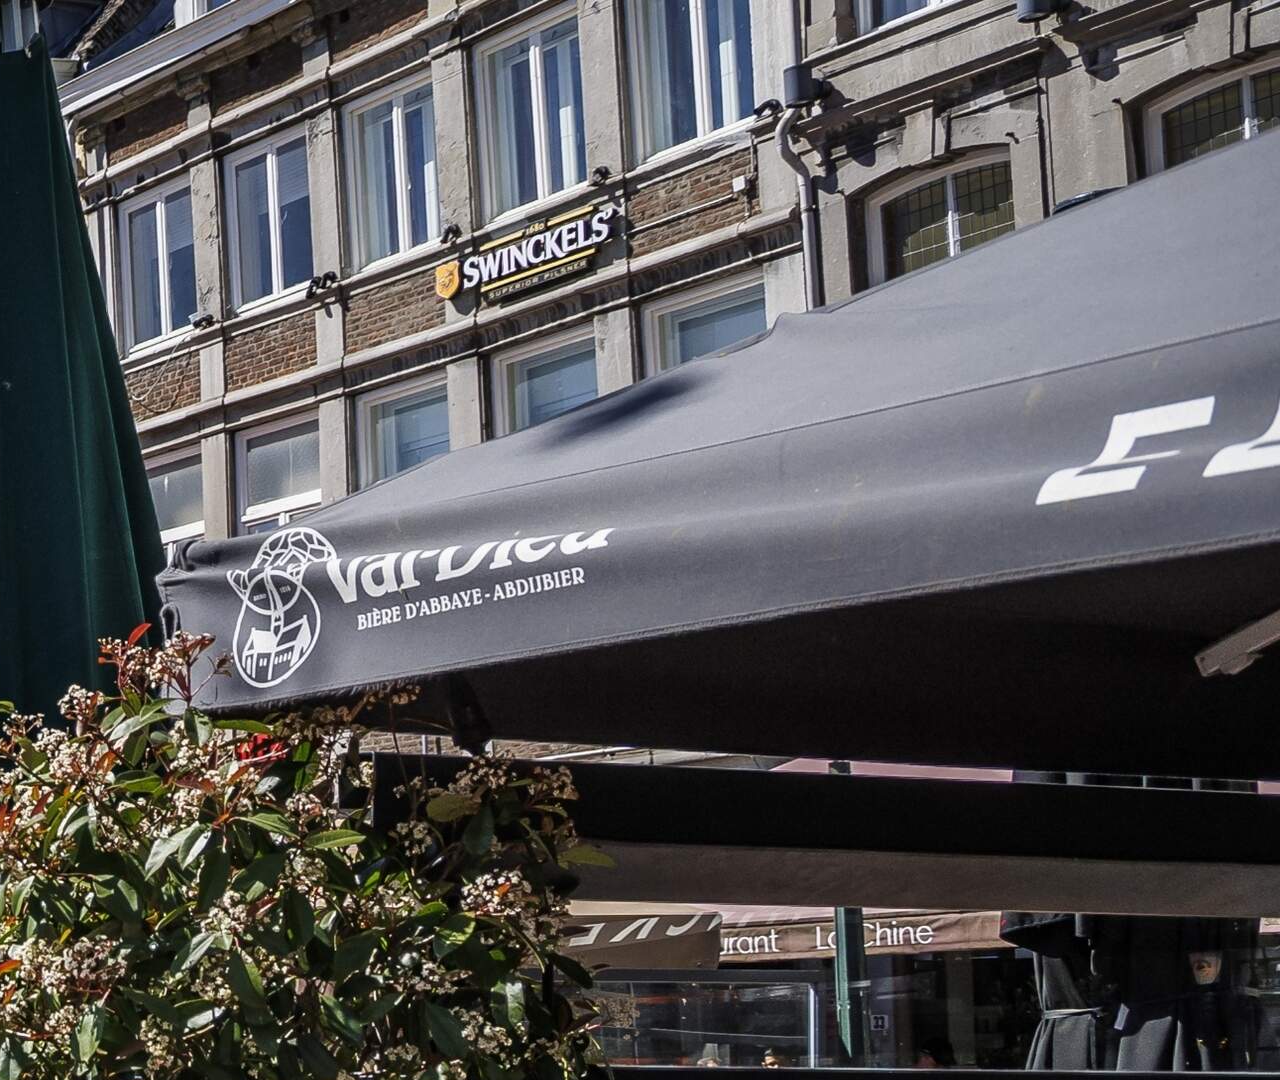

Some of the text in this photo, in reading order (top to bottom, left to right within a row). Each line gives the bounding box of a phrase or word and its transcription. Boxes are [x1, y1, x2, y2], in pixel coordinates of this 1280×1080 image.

[463, 208, 613, 289] SWINCKELS'
[489, 260, 587, 299] SUPERIOR PILSNER
[357, 605, 402, 631] BIÈRE
[405, 588, 483, 621] D'ABBAYE
[493, 566, 586, 602] ABDIJBIER
[720, 928, 780, 956] urant
